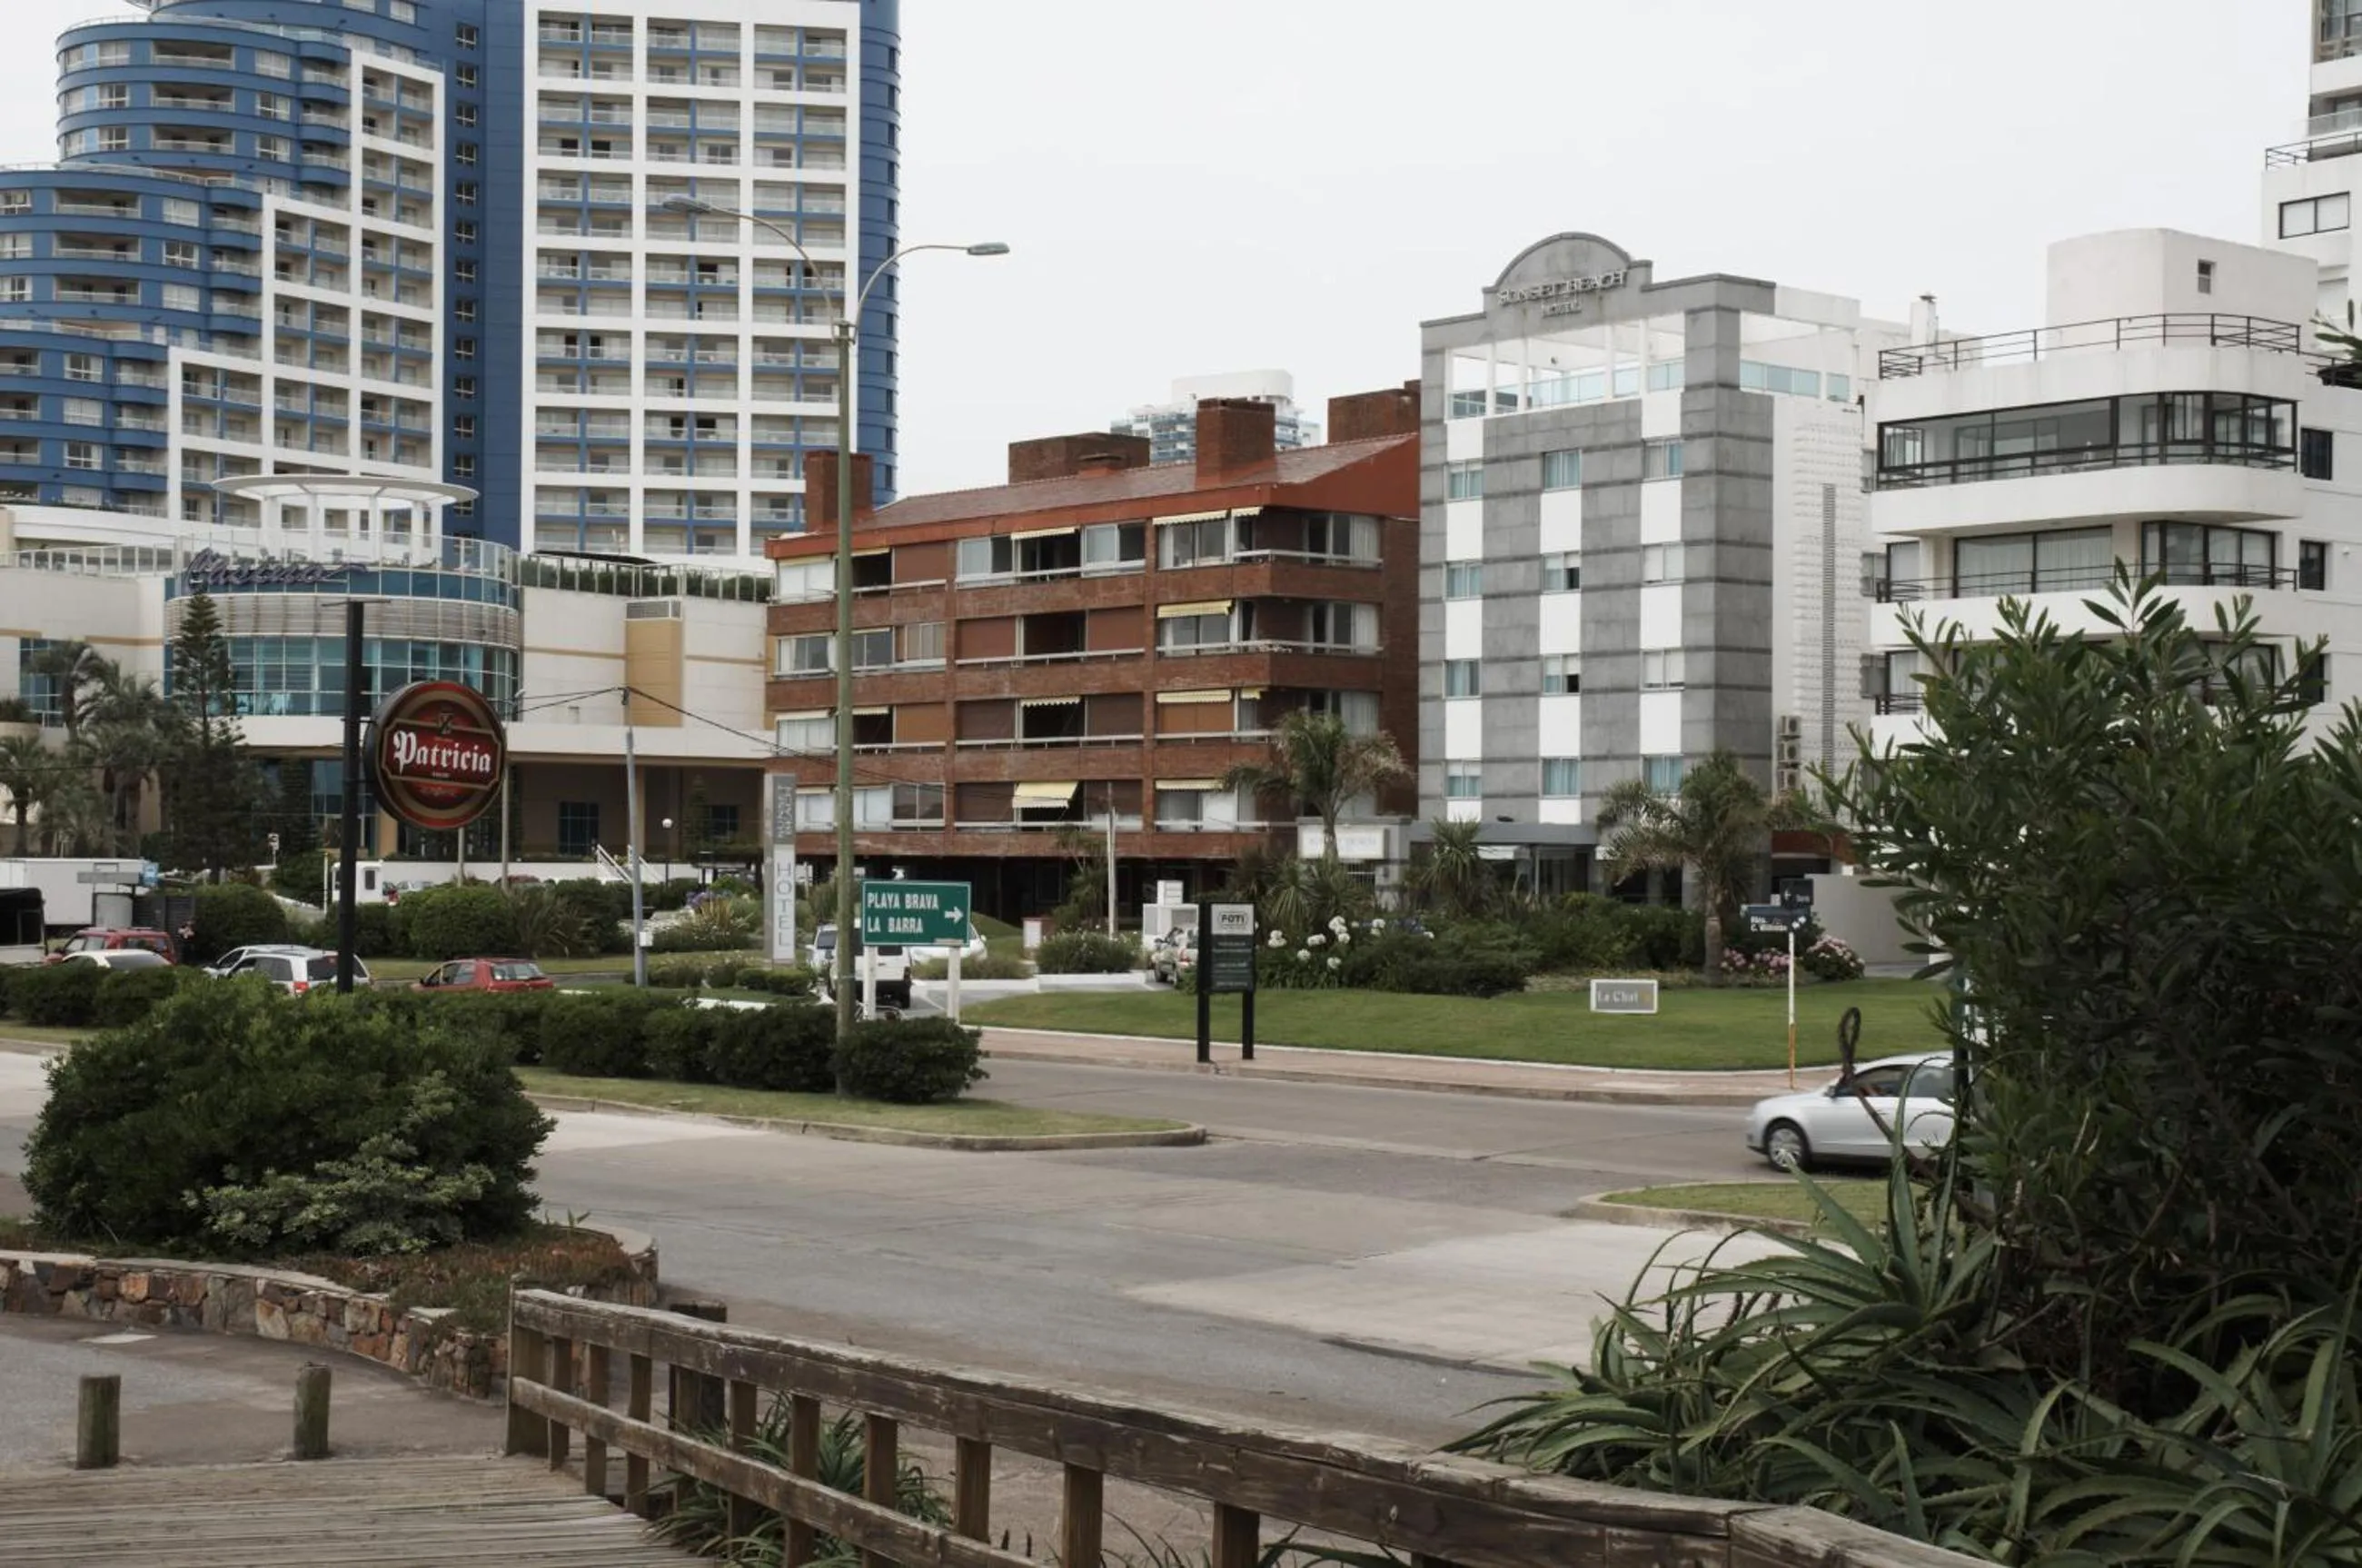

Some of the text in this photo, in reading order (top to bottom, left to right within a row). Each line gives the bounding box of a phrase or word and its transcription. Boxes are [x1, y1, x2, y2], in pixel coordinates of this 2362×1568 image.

[392, 729, 491, 773] Patricia
[777, 862, 792, 947] HOTEL
[867, 892, 939, 909] PLAYA BRAVA
[867, 917, 924, 933] LA BARRA
